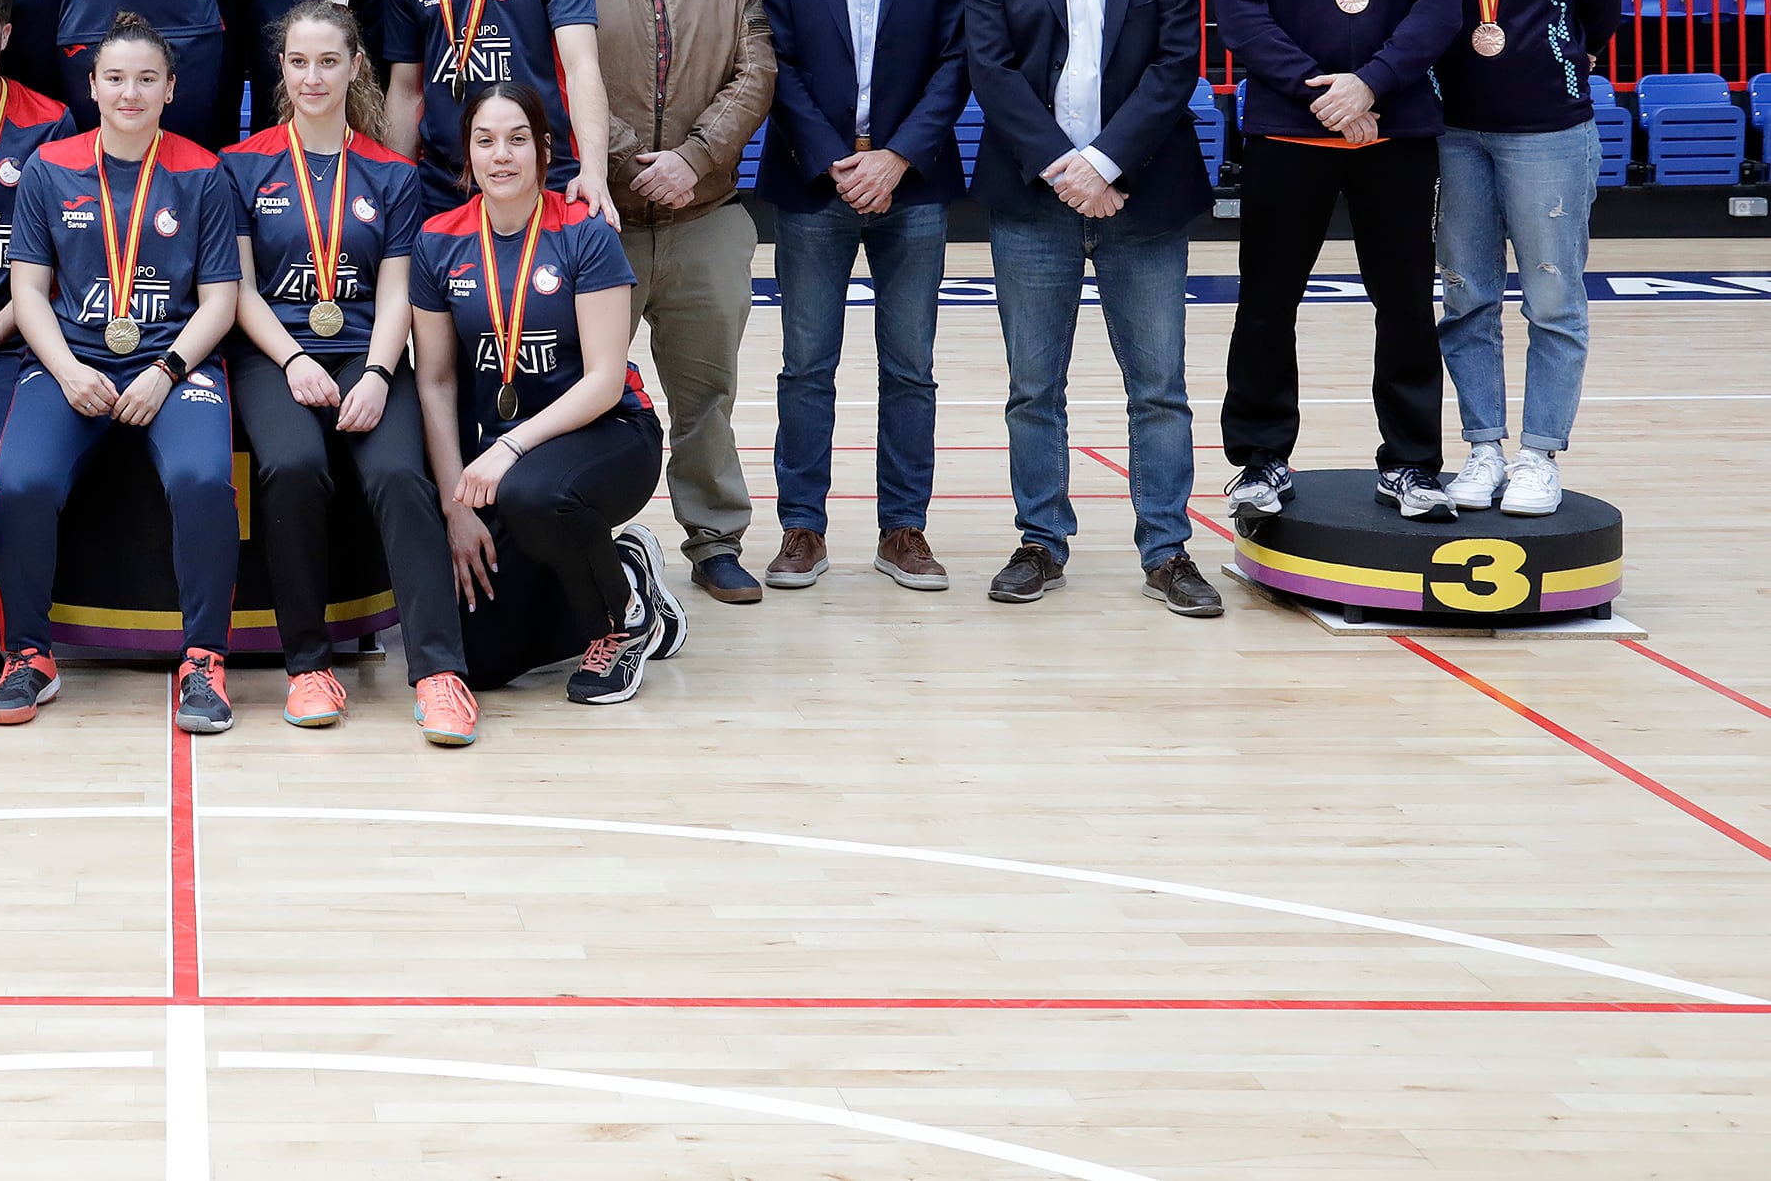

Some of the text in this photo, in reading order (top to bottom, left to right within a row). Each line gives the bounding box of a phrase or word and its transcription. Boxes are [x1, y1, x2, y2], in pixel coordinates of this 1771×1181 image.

[255, 197, 290, 208] Joma
[61, 210, 95, 222] Joma
[1429, 538, 1532, 612] 3
